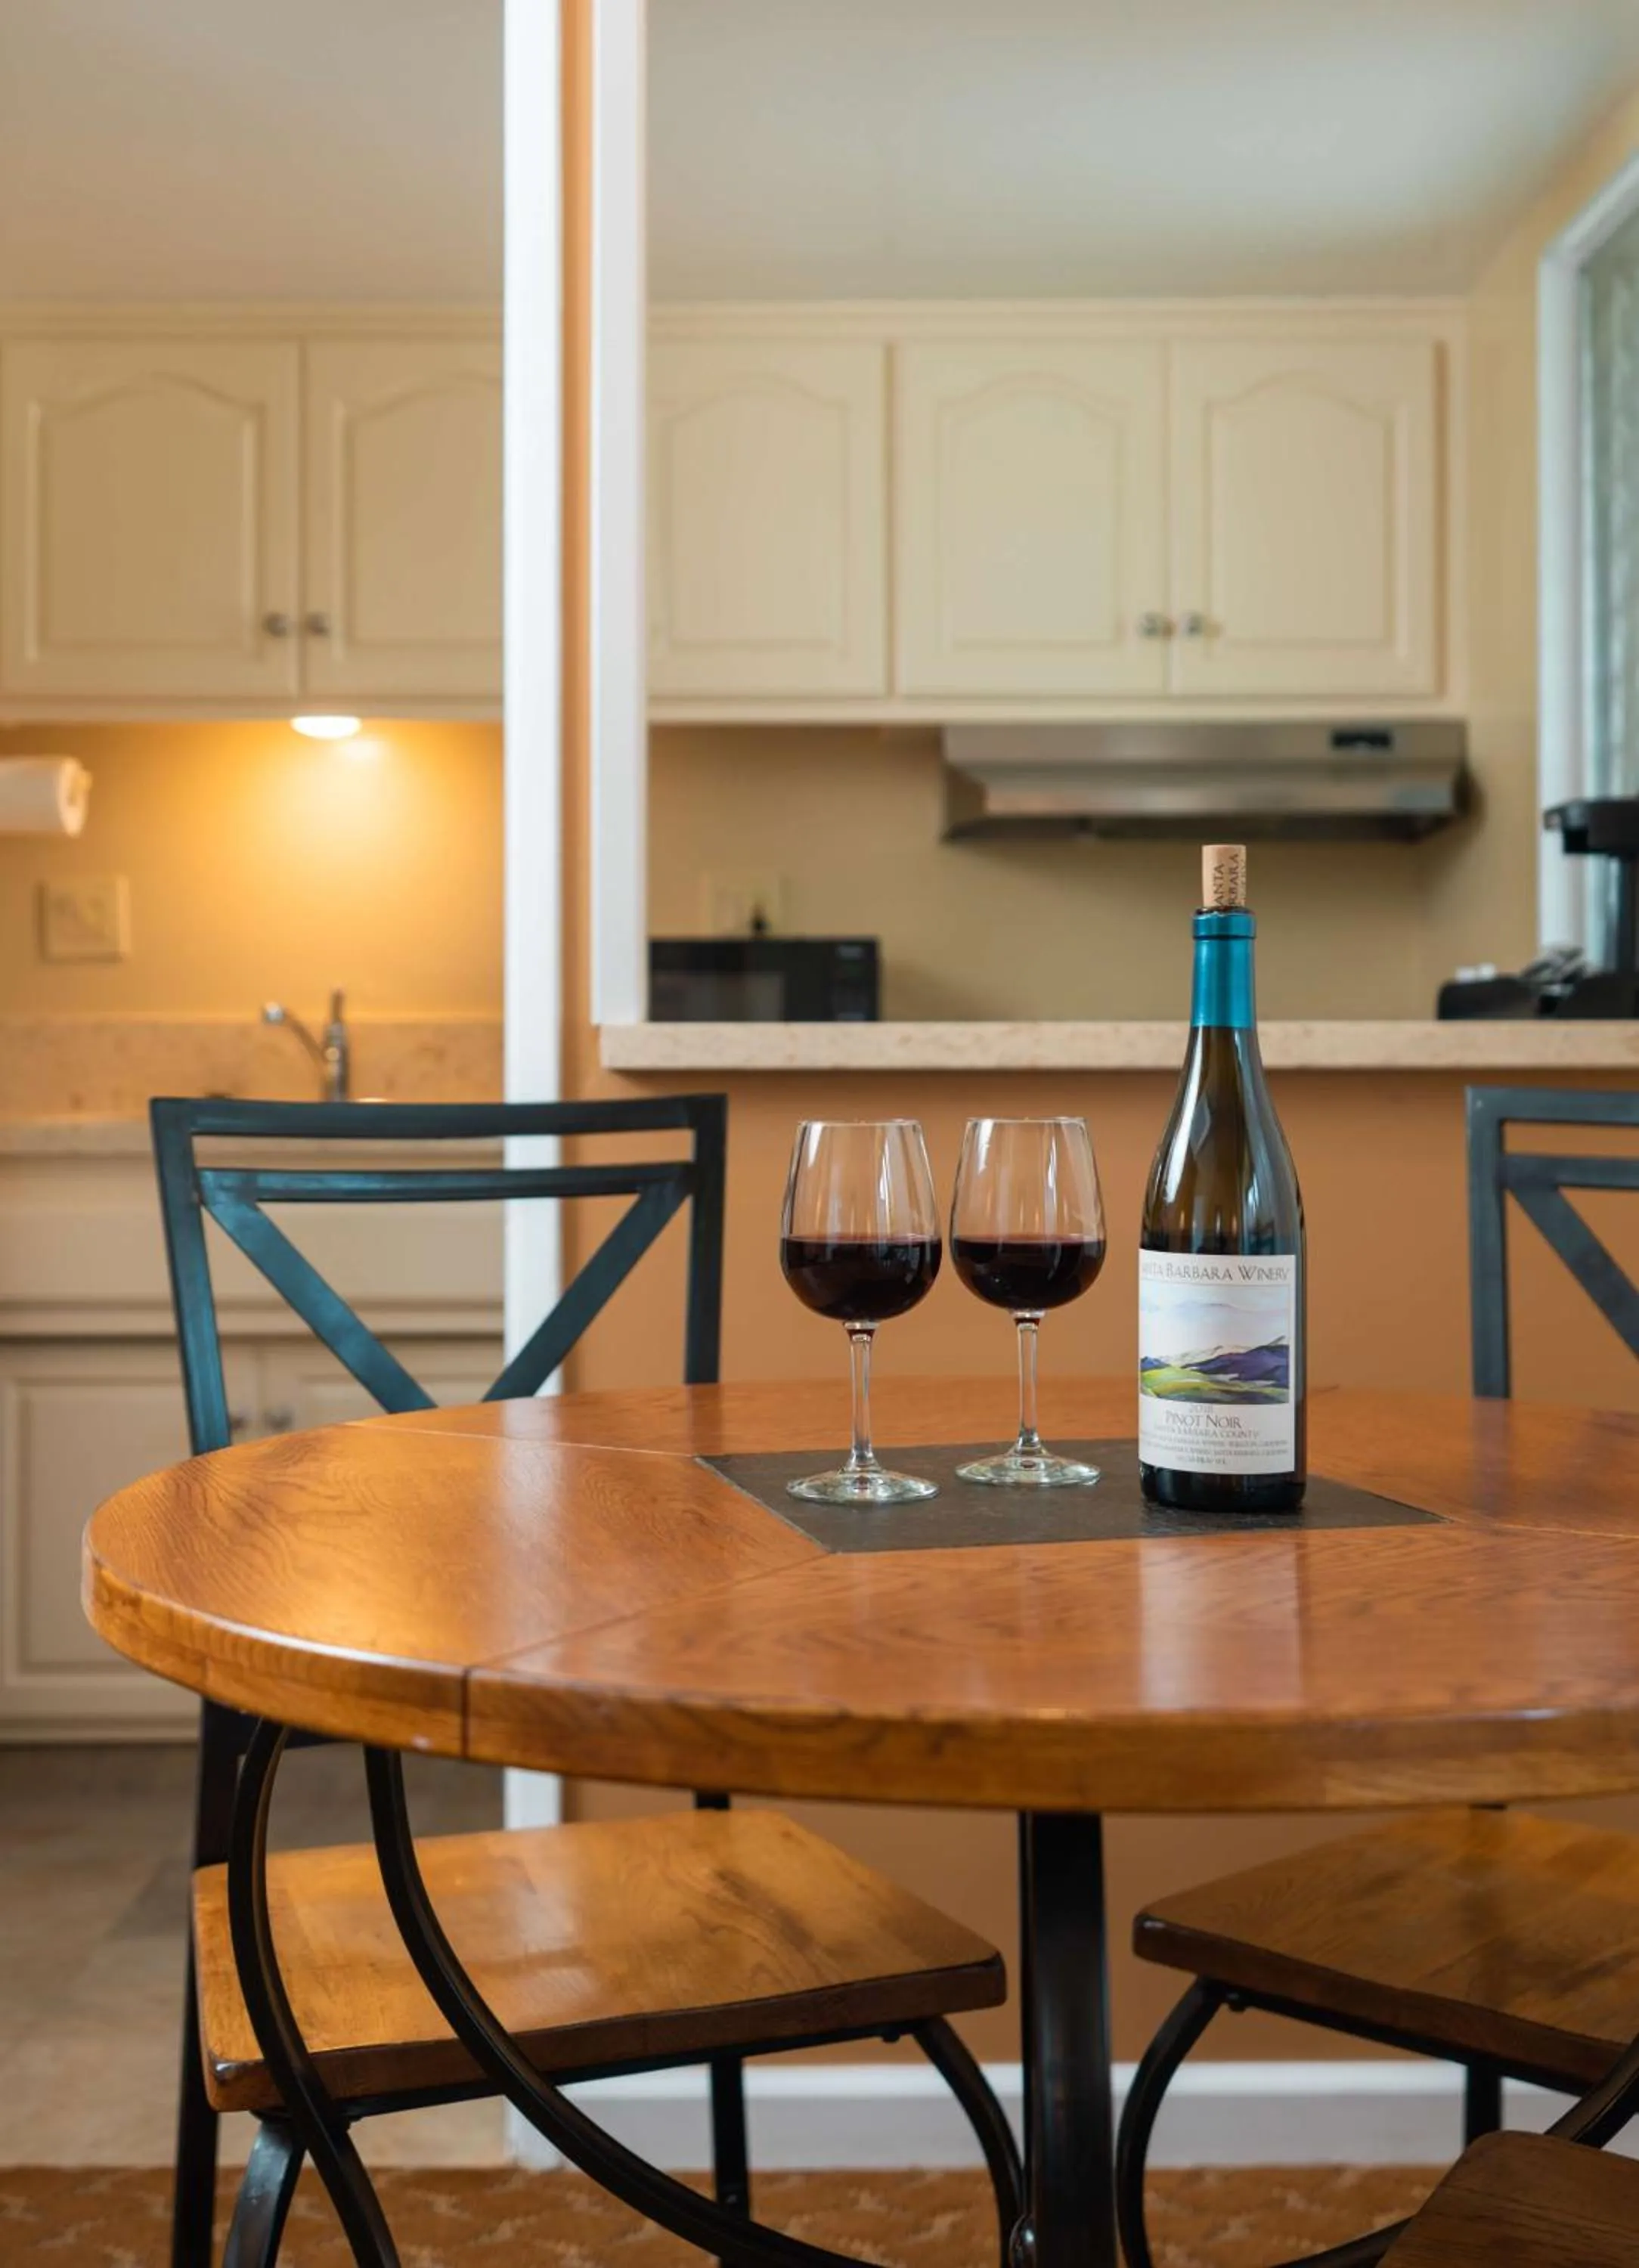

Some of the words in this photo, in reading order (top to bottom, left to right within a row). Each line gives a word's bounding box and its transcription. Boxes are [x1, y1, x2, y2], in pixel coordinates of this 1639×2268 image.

[1213, 863, 1224, 906] ANTA
[1166, 1262, 1233, 1281] BARBARA
[1237, 1264, 1290, 1281] WINERY
[1165, 1409, 1201, 1428] PINOT
[1206, 1414, 1242, 1428] NOIR
